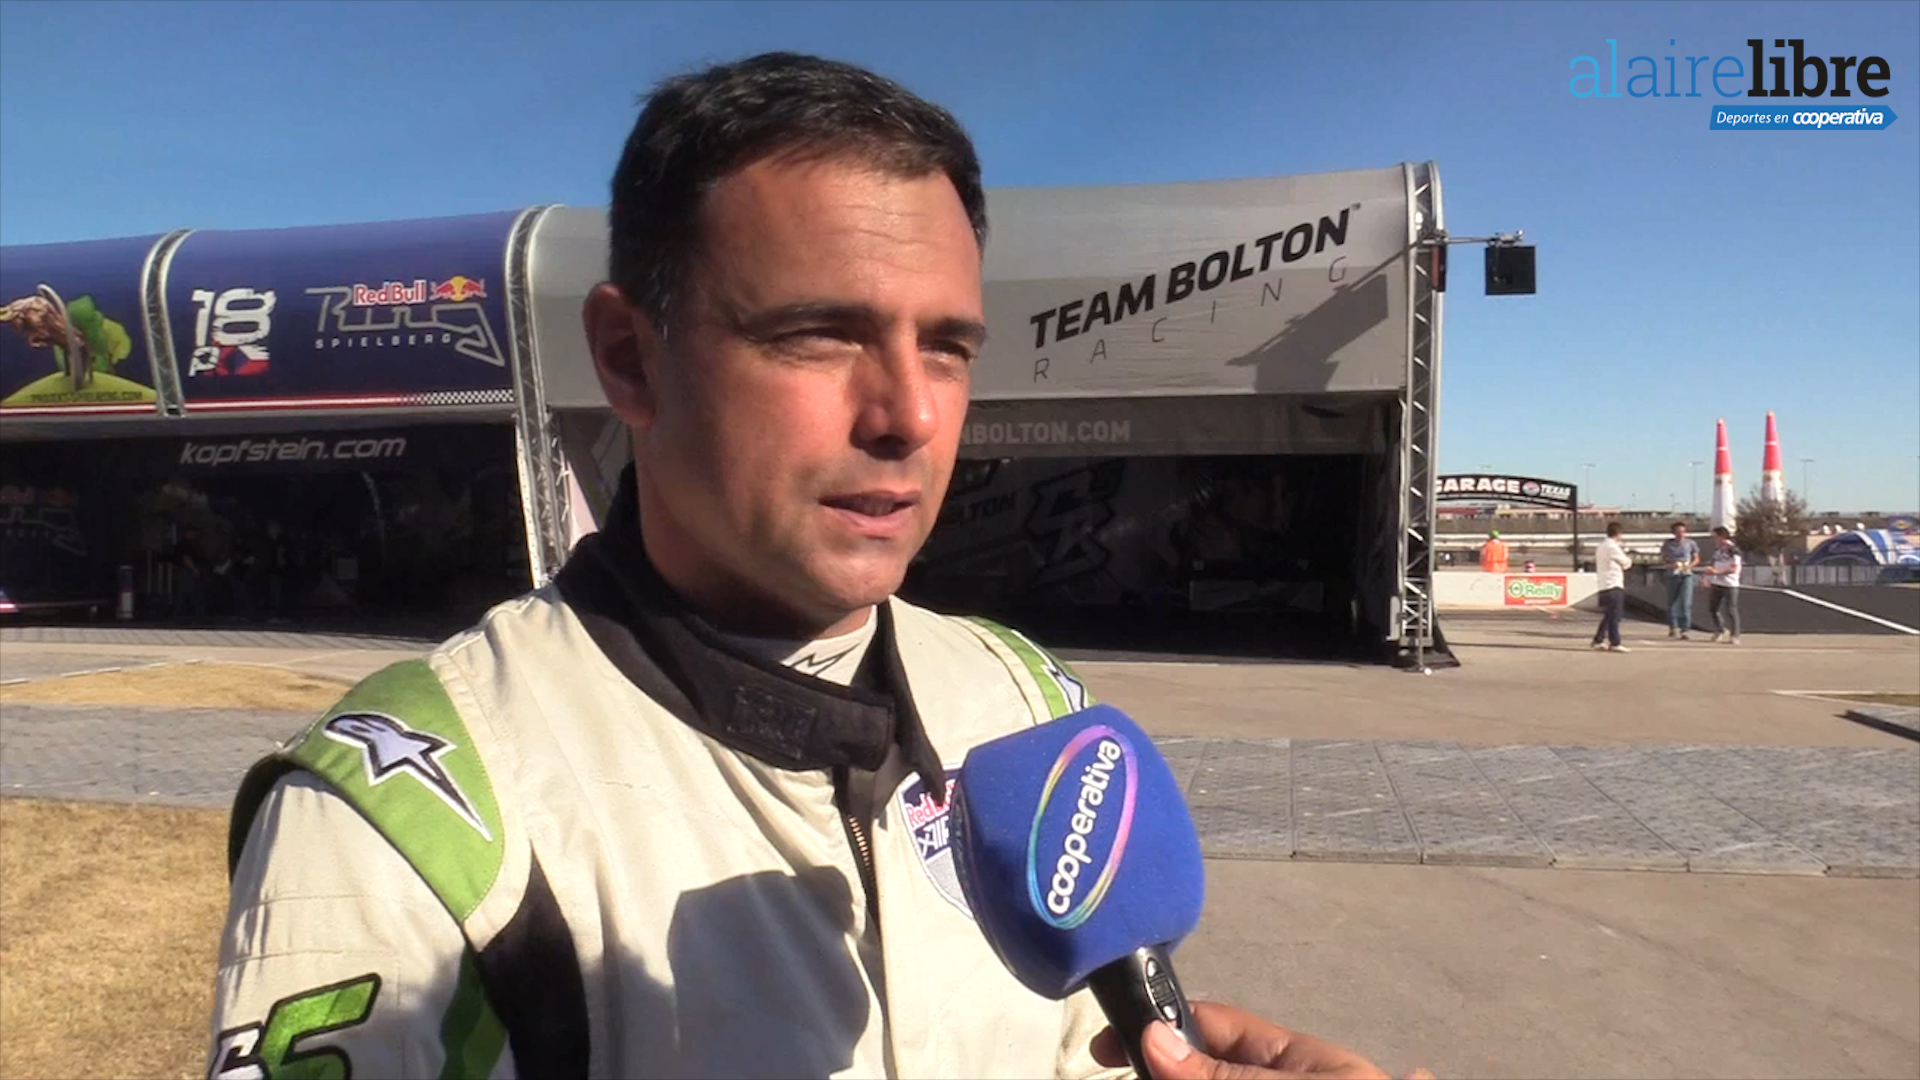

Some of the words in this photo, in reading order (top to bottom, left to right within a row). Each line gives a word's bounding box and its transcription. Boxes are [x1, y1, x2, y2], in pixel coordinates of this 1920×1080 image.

[1030, 274, 1155, 349] TEAM
[1165, 208, 1349, 304] BOLTON
[192, 288, 277, 346] 18
[315, 334, 451, 349] SPIELBERG
[180, 437, 406, 466] kopfstein.com
[1541, 484, 1571, 496] TEXAS
[1047, 739, 1121, 915] cooperativa
